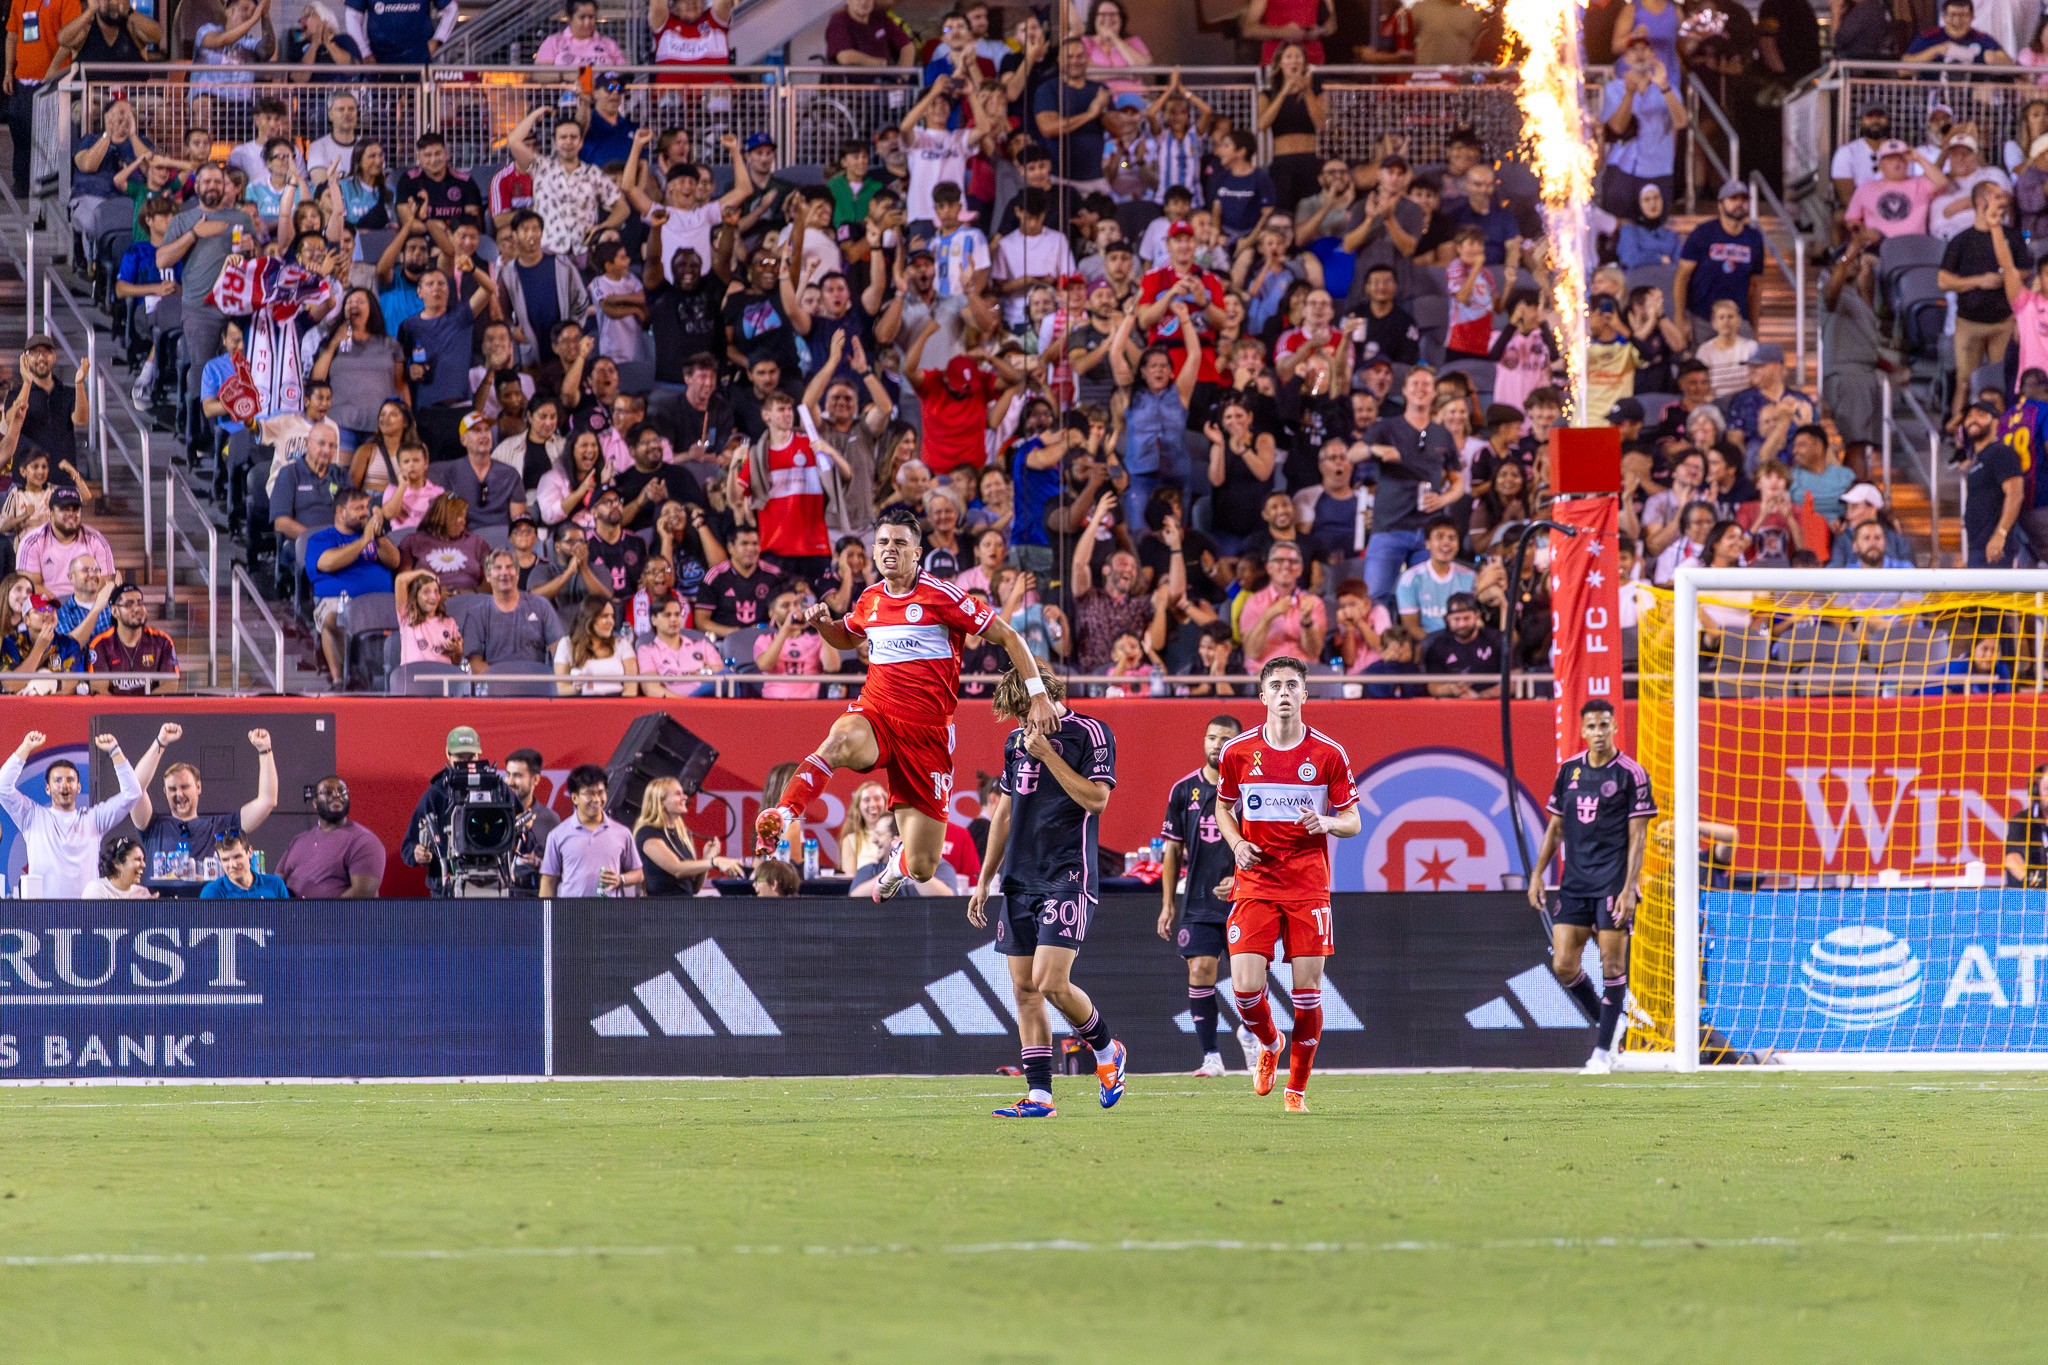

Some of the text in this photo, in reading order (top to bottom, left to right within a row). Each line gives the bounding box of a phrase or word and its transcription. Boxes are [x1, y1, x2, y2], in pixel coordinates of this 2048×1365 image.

[875, 639, 922, 651] CARVANA
[1586, 607, 1609, 653] FC
[930, 771, 953, 801] 19
[1264, 797, 1314, 807] CARVANA
[1042, 899, 1078, 926] 30
[1311, 906, 1330, 936] 17
[0, 928, 266, 988] RUST
